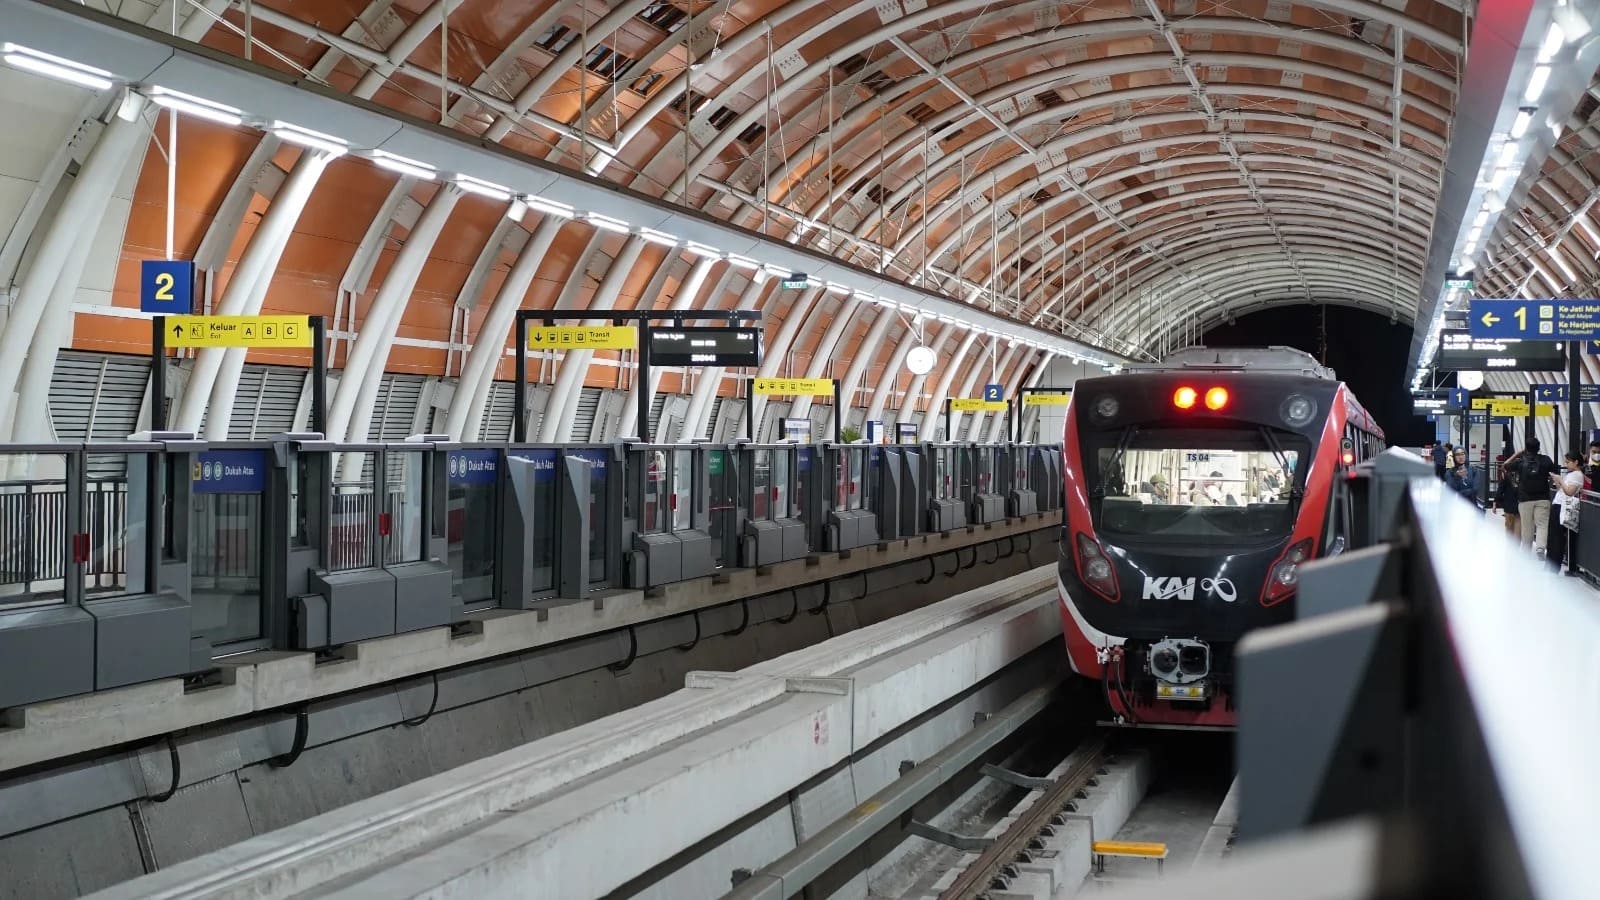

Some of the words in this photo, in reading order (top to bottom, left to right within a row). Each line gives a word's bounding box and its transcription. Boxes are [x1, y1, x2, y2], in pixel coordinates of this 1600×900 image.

[155, 273, 174, 300] 2
[1559, 305, 1568, 313] Ke
[1570, 305, 1584, 313] Jati
[1514, 307, 1527, 331] 1
[210, 323, 236, 331] Keluar
[1559, 321, 1568, 329] Ke
[266, 327, 272, 335] B
[286, 327, 293, 335] C
[988, 388, 998, 399] 2
[1557, 387, 1563, 398] 1
[1456, 392, 1462, 403] 1
[1187, 453, 1197, 461] TS
[1199, 453, 1209, 461] 04
[468, 461, 484, 470] Dukuh
[485, 461, 495, 470] Atas
[225, 466, 242, 475] Dukuh
[243, 466, 254, 475] Atas
[1142, 577, 1196, 600] KAI
